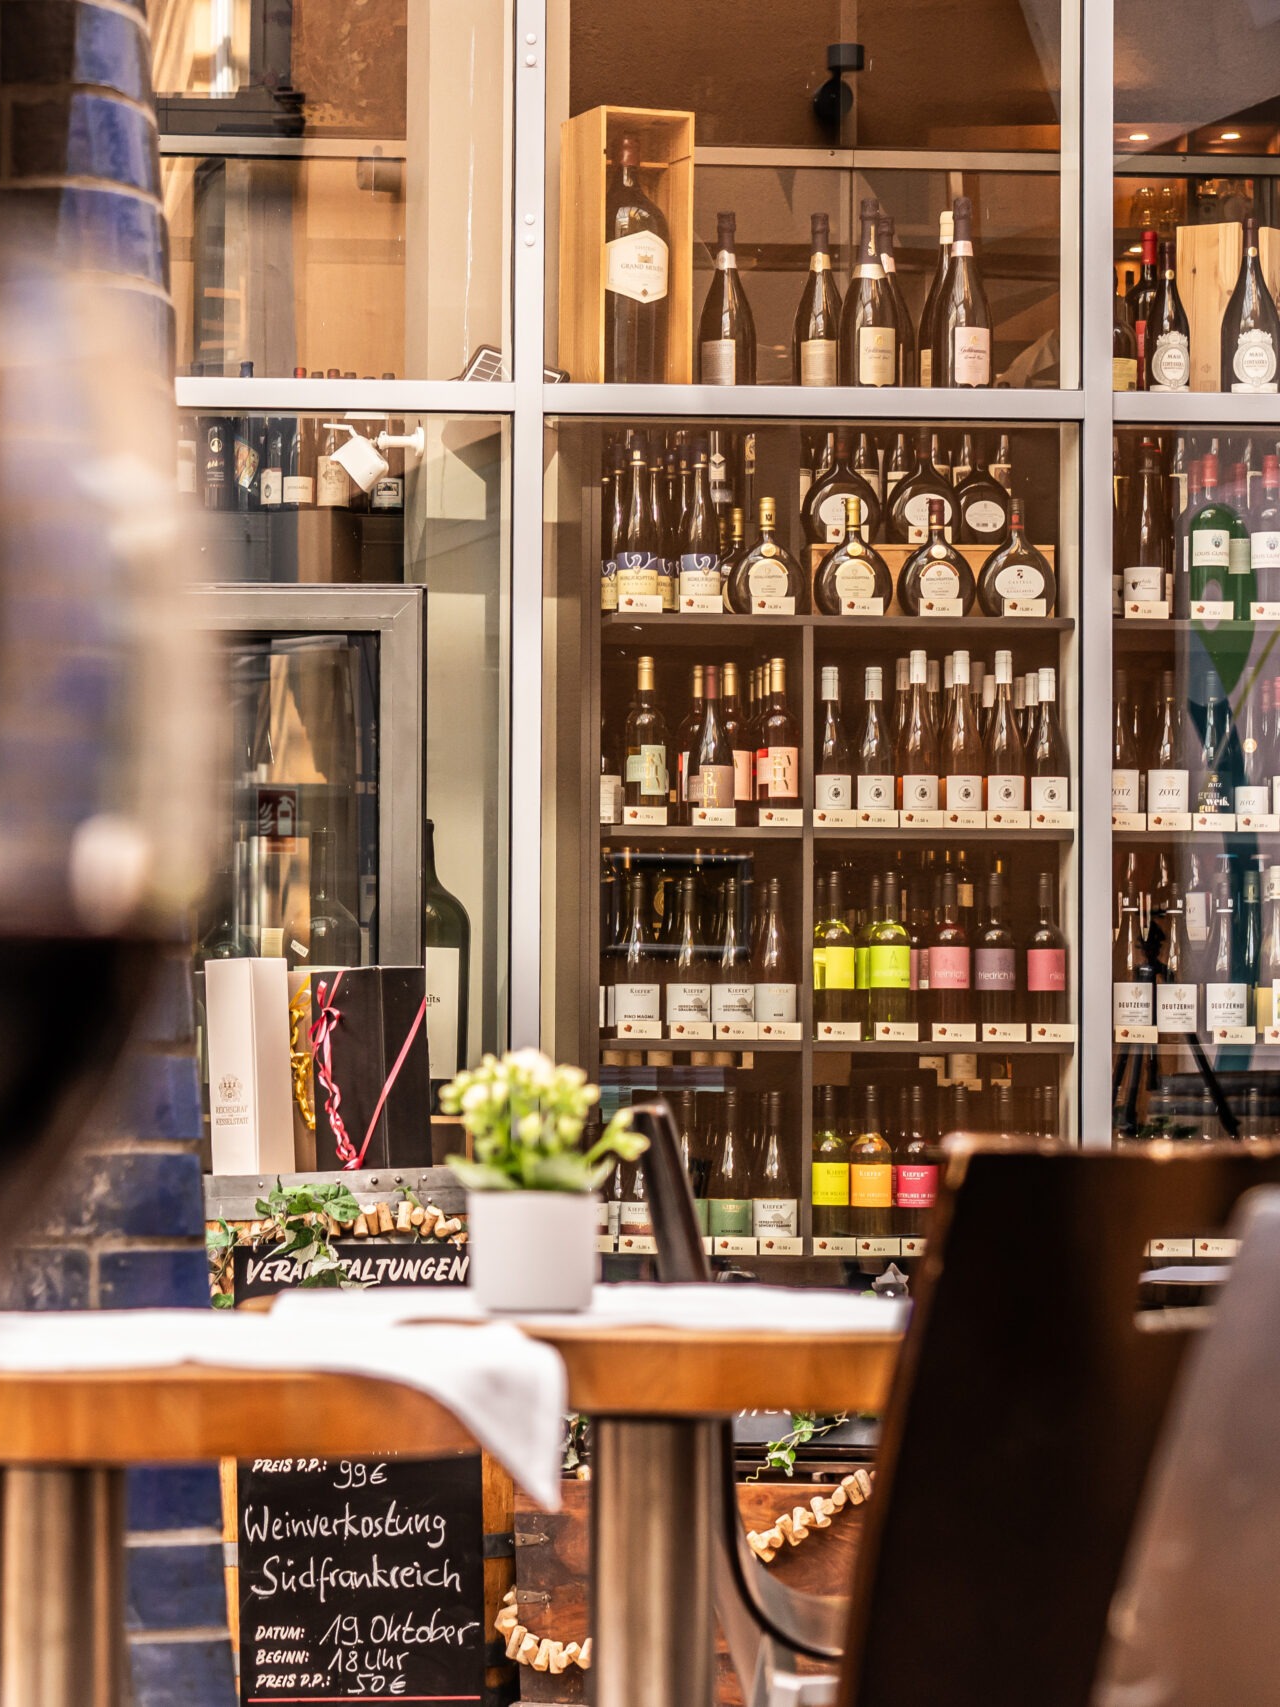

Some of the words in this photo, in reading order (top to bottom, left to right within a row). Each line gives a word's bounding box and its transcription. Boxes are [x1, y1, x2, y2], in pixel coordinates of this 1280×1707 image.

[1158, 789, 1181, 797] ZOTZ
[978, 971, 1009, 980] friedrich
[246, 1255, 470, 1285] VERATALTUNGEN
[252, 1458, 292, 1472] PREIS
[333, 1460, 388, 1489] 99€
[244, 1500, 447, 1548] Weinverkostung
[251, 1554, 461, 1603] Südfrankreich
[255, 1626, 305, 1641] DATUM:
[370, 1608, 480, 1646] Oktober
[256, 1649, 309, 1665] BEGINN:
[328, 1648, 358, 1672] 18
[364, 1651, 410, 1671] Uhr
[256, 1674, 297, 1688] PREIS
